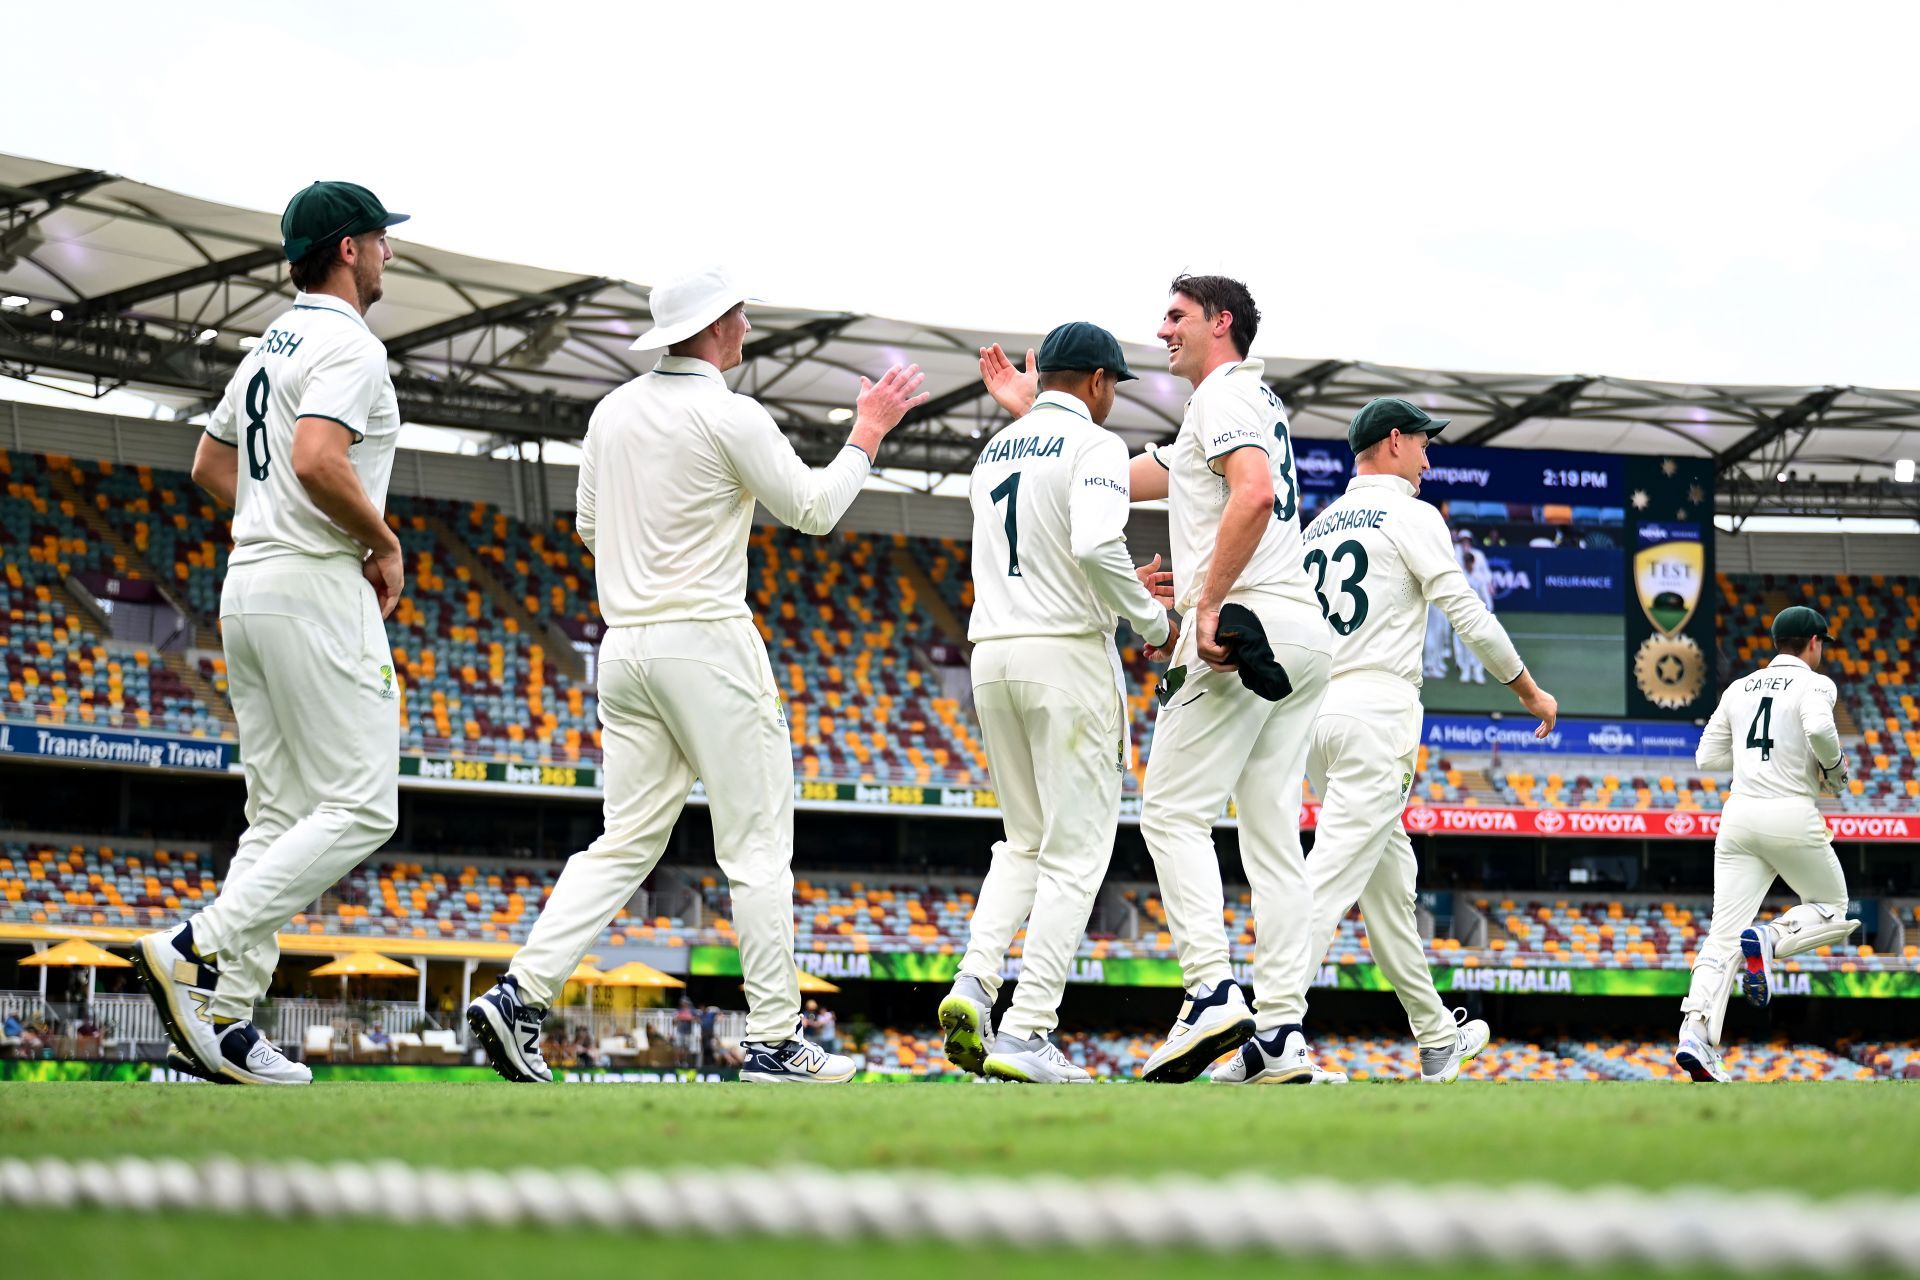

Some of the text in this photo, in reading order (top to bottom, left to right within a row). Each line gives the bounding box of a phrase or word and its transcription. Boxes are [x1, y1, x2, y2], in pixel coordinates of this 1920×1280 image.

[256, 328, 304, 358] RSH
[245, 366, 271, 482] 8
[1423, 466, 1490, 488] ompany
[1542, 469, 1608, 488] 2:19 PM
[990, 471, 1023, 577] 1
[1544, 575, 1613, 589] INSURANCE
[1744, 678, 1794, 693] CAREY
[1444, 725, 1483, 746] Help
[1484, 725, 1562, 749] Compy
[1746, 696, 1774, 762] 4
[37, 731, 223, 768] Transforming Travel
[419, 757, 488, 781] bet365
[506, 762, 577, 787] bet365
[855, 783, 924, 805] bet365
[941, 787, 999, 807] bet36
[1440, 810, 1517, 831] TOYOTA
[1568, 813, 1647, 833] TOYOTA
[1829, 817, 1909, 836] TOYOTA
[1451, 967, 1573, 993] AUSTRALIA
